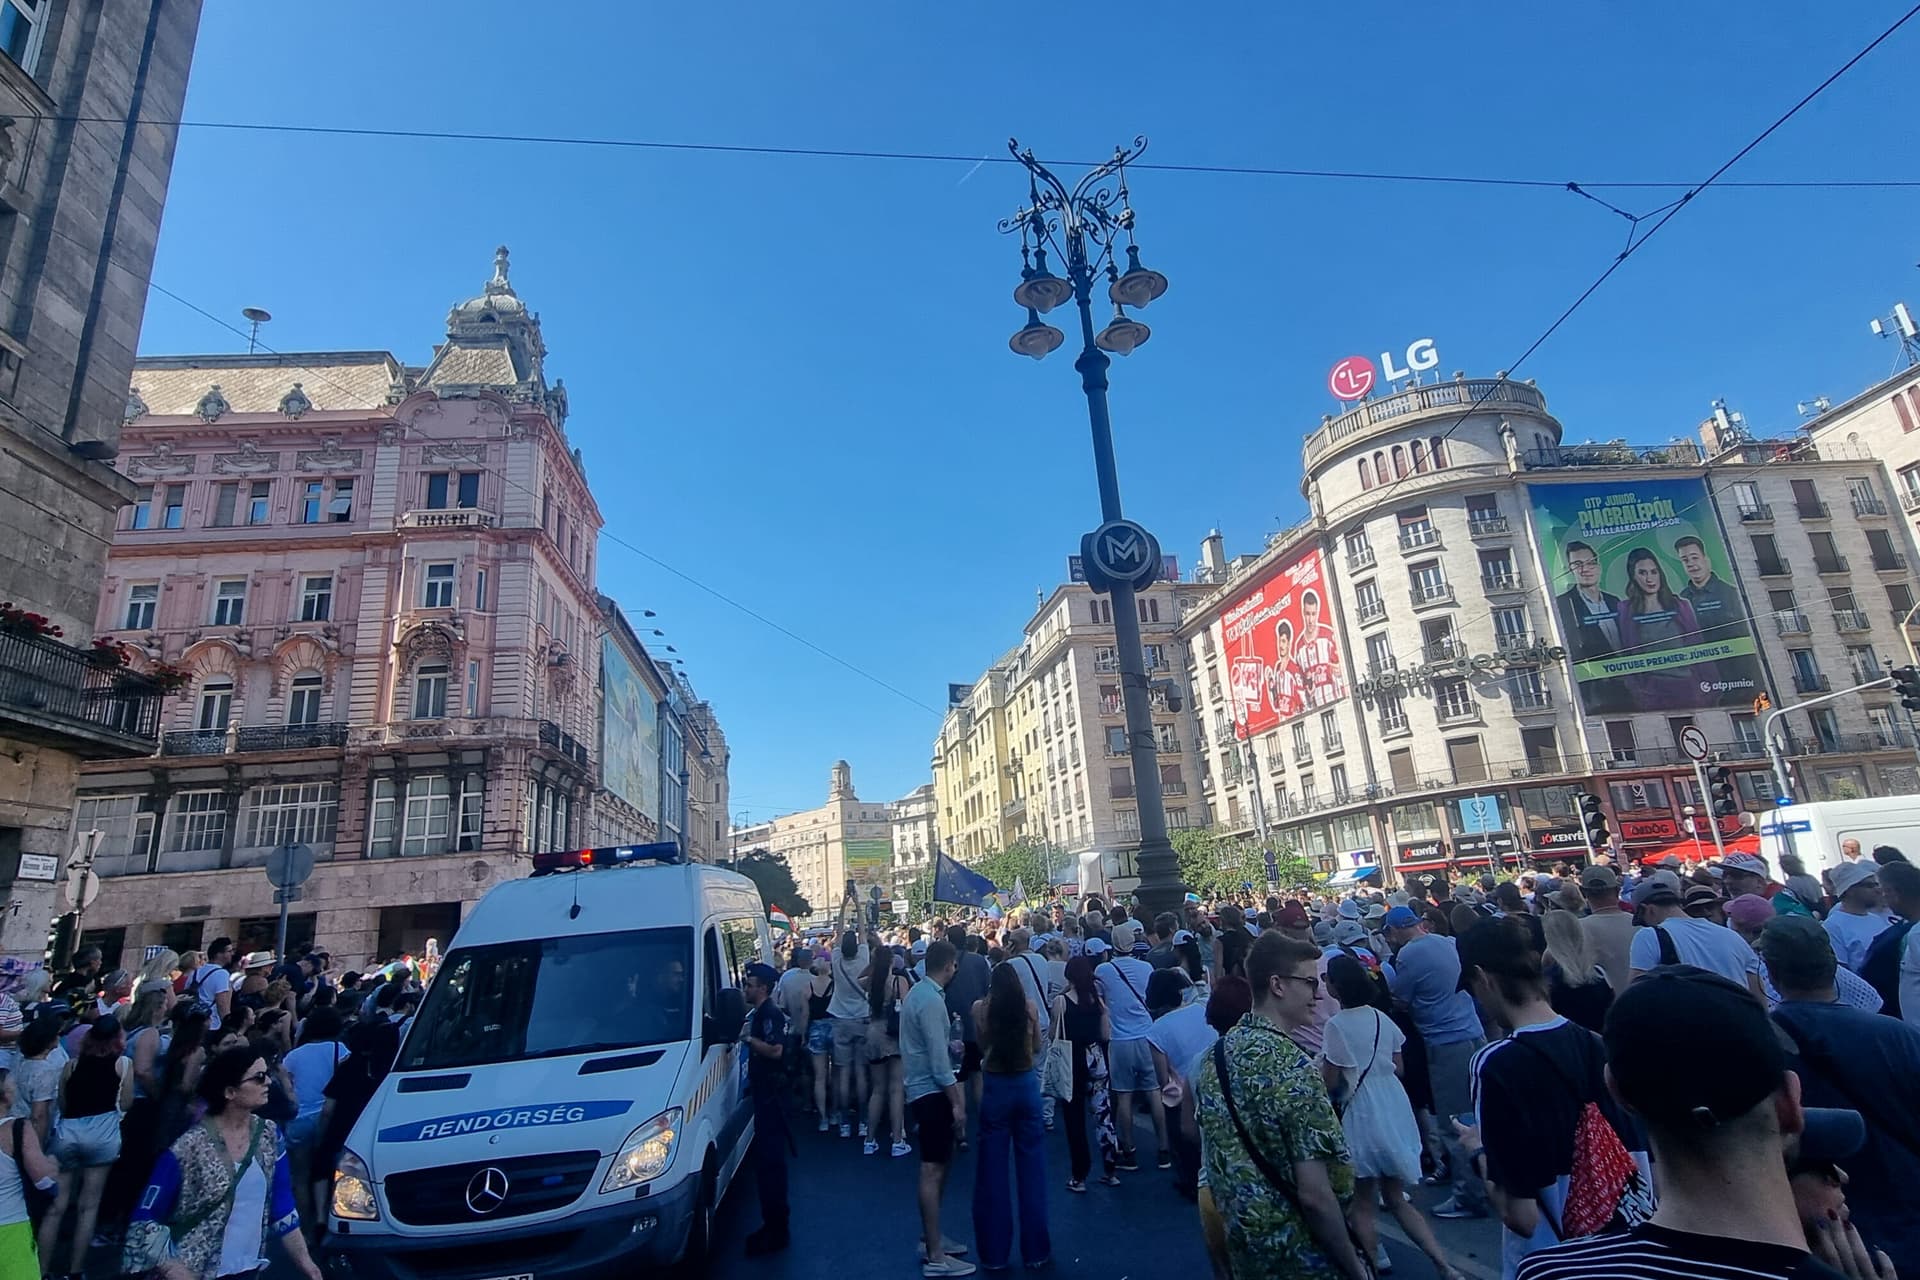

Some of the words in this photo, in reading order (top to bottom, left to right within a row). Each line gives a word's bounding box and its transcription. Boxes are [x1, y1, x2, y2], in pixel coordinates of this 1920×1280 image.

[1380, 338, 1439, 382] LG
[1584, 496, 1602, 509] OTP
[1605, 492, 1637, 506] JUNIOR
[1453, 641, 1566, 676] gorenje
[1602, 660, 1646, 673] YOUTUBE
[1646, 654, 1688, 667] PREMIER:
[1689, 647, 1720, 660] JÚNIUS
[1353, 662, 1434, 700] gorenje
[1539, 829, 1586, 846] JÓKENYÉ
[418, 1105, 585, 1140] RENDŐRSÉG
